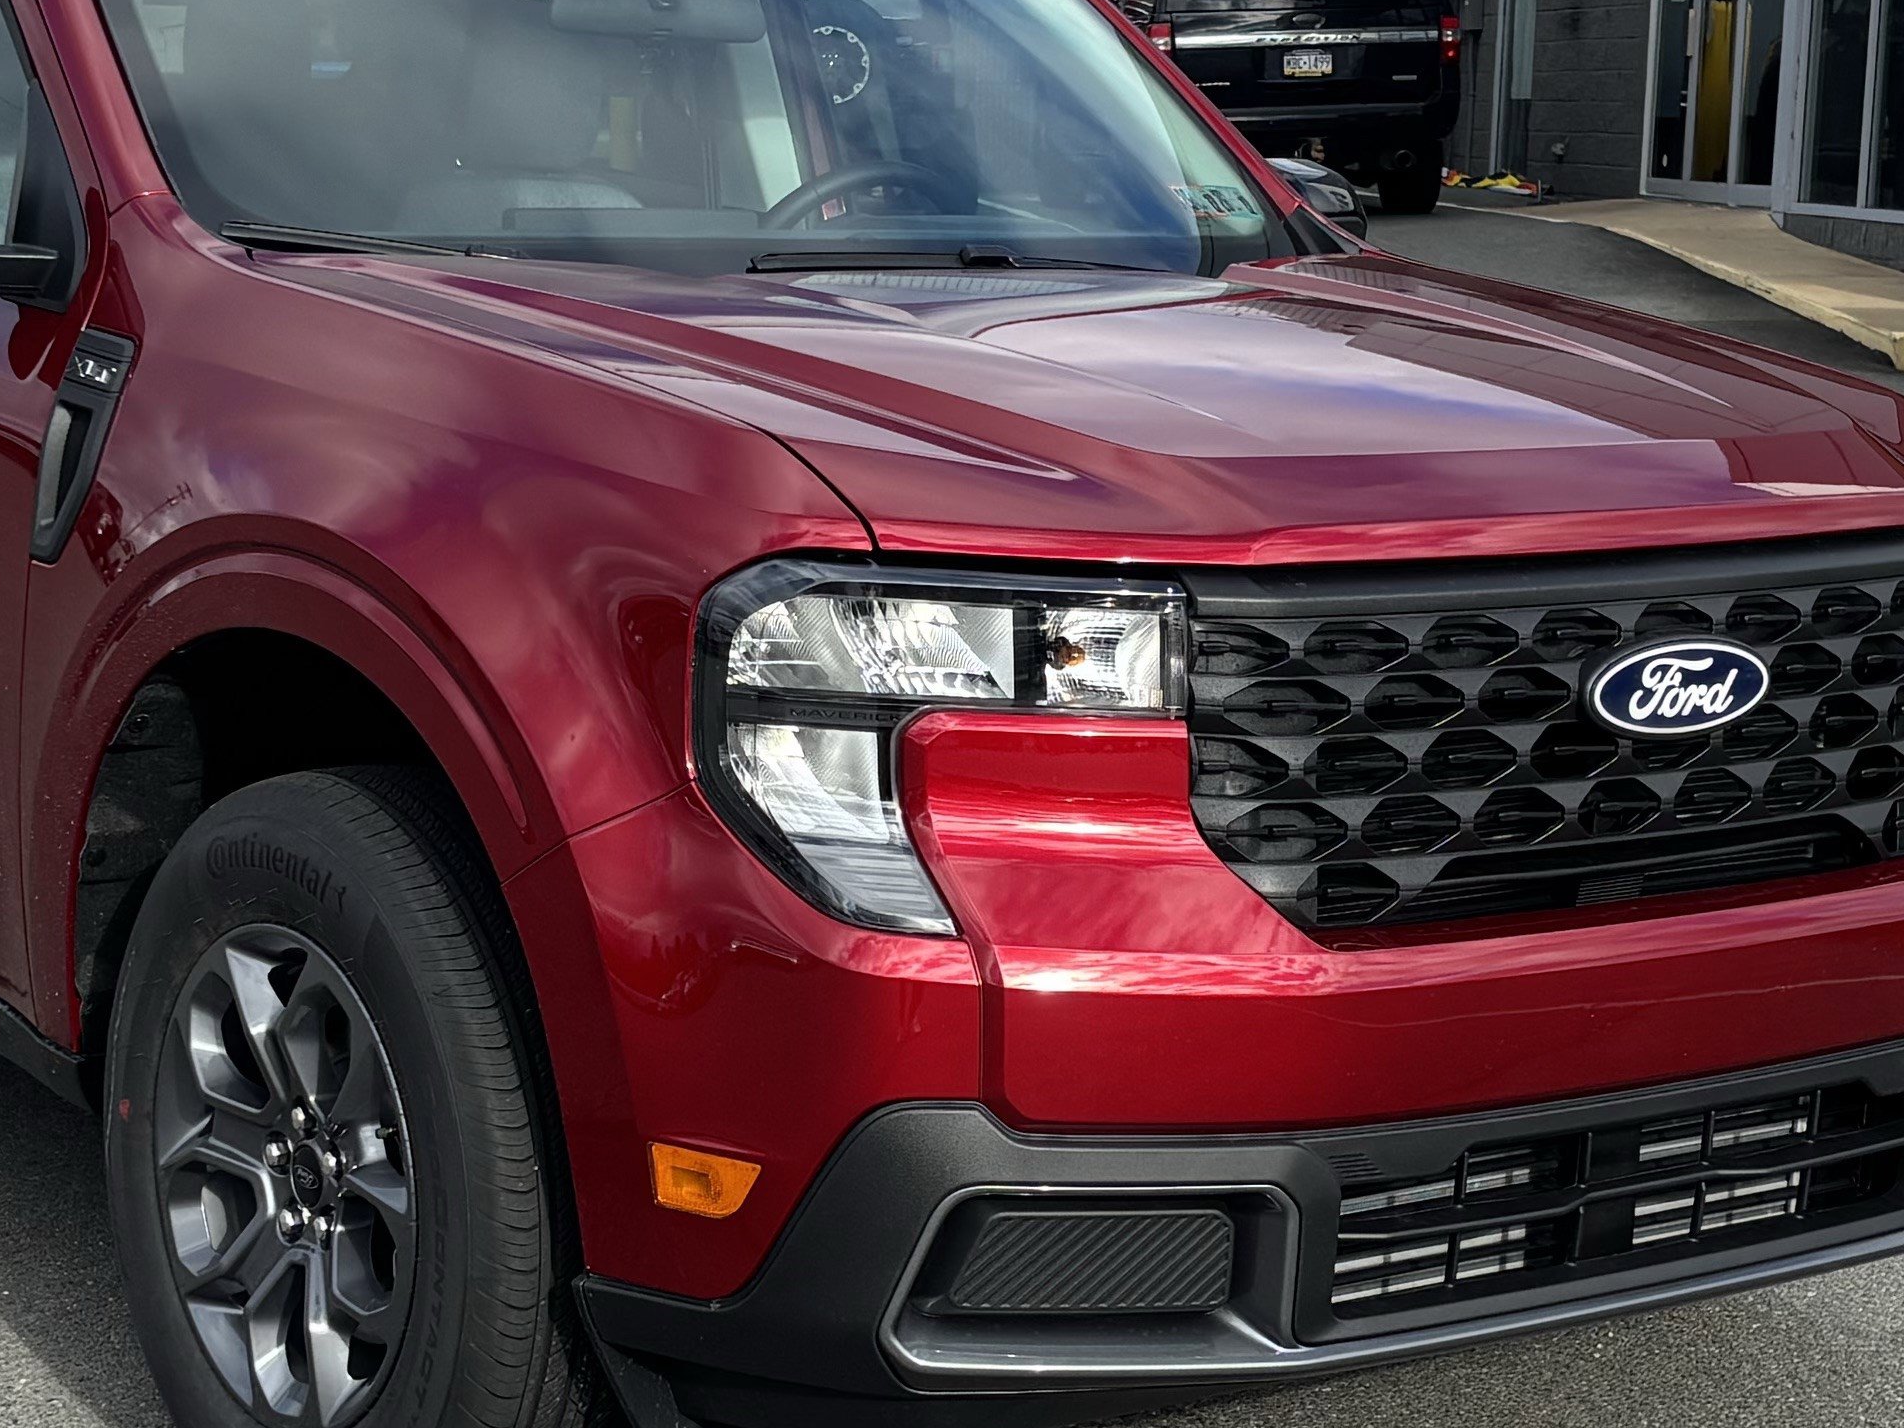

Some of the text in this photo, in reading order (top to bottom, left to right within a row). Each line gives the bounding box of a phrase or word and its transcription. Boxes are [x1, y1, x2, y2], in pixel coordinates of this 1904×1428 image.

[74, 356, 118, 384] XLT
[1628, 656, 1739, 721] Ford
[789, 708, 904, 723] MAVERICK
[206, 832, 334, 904] Continental
